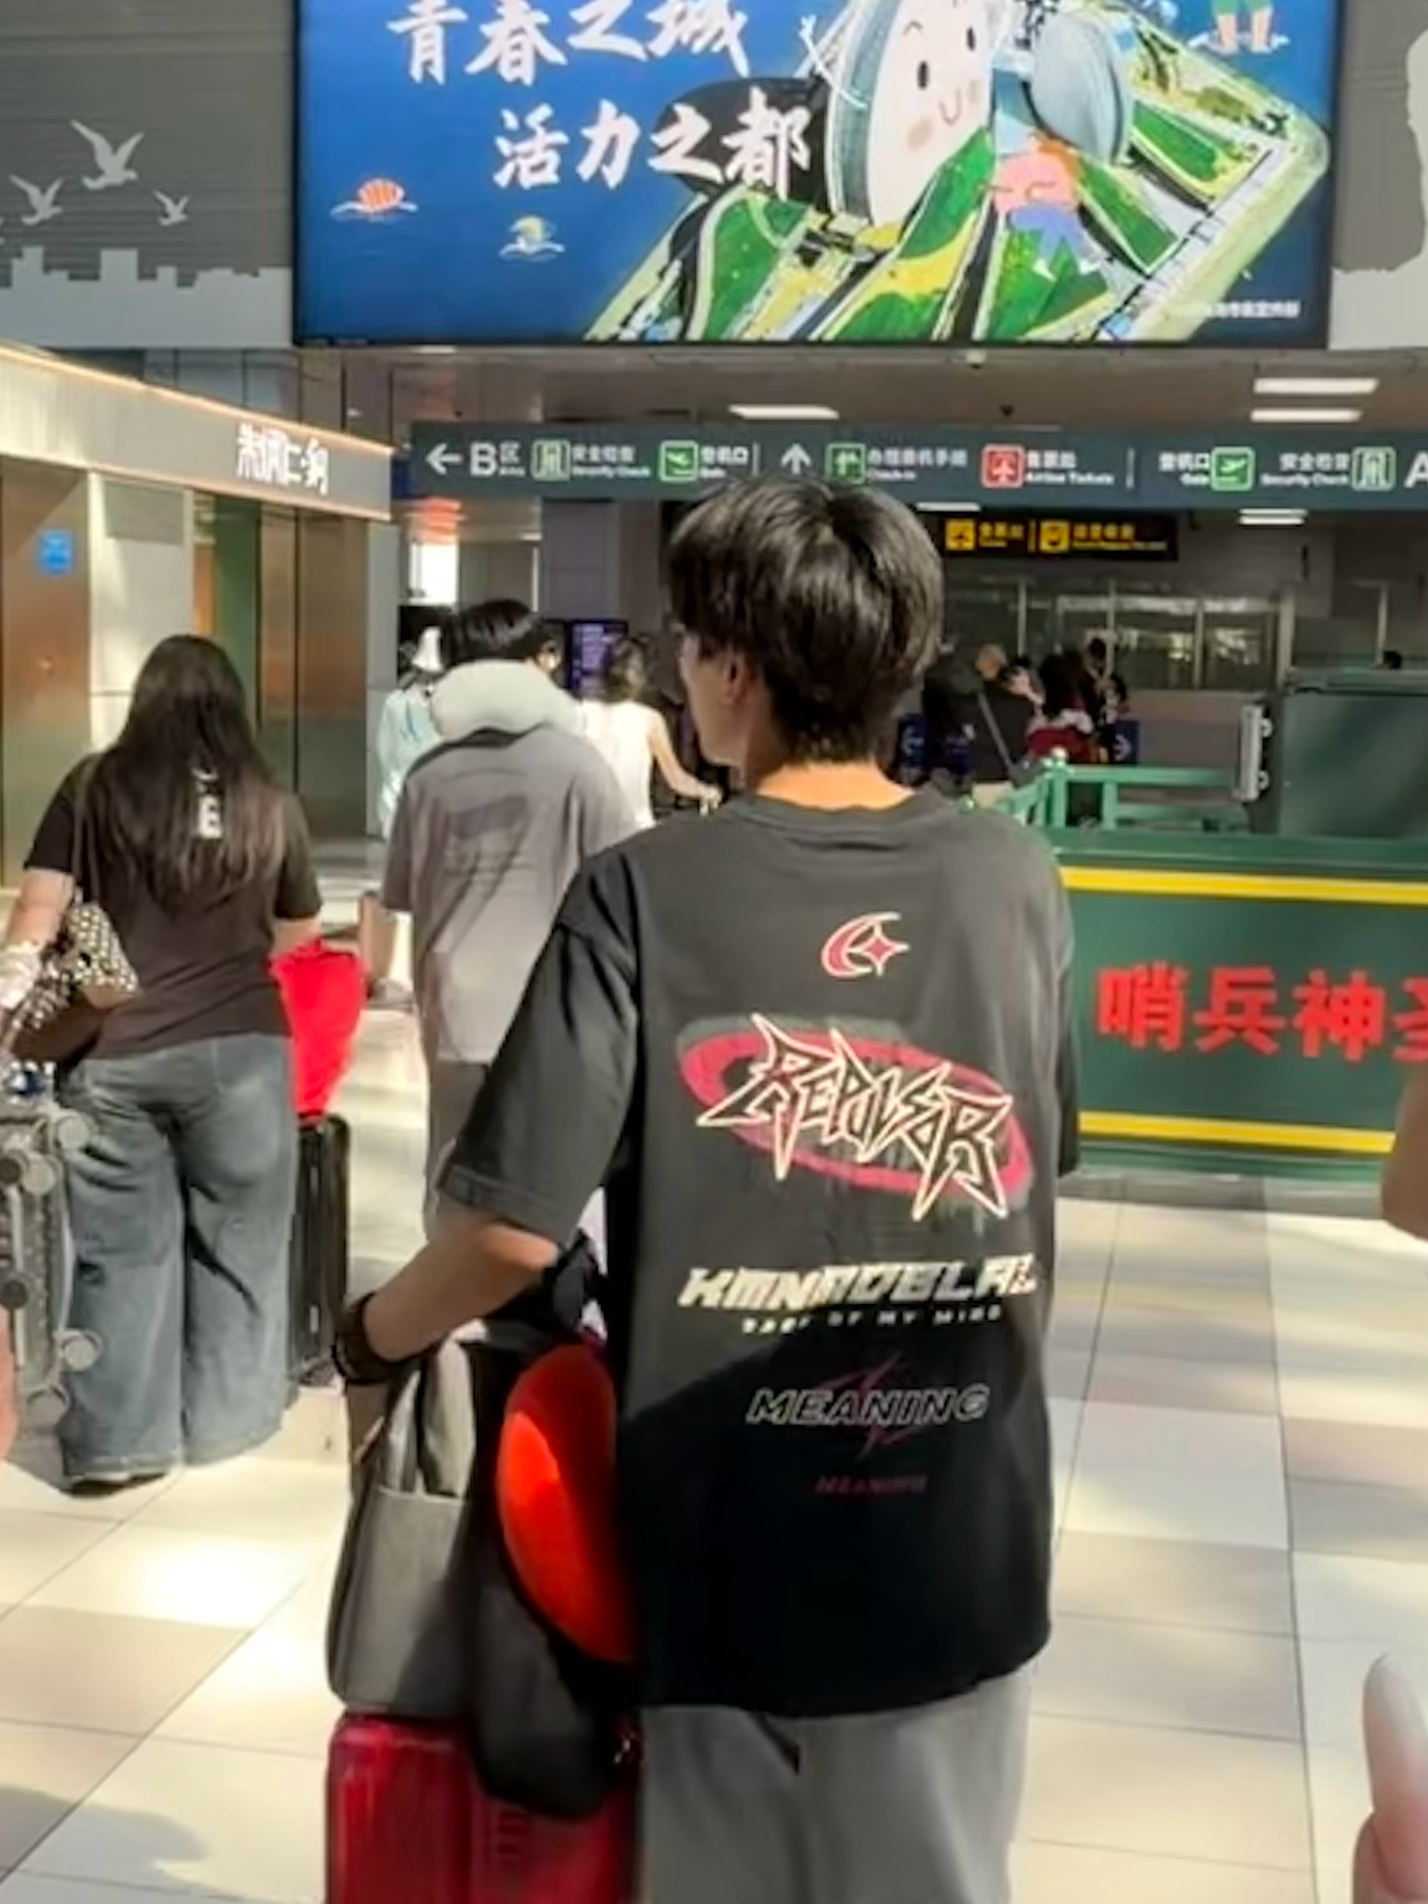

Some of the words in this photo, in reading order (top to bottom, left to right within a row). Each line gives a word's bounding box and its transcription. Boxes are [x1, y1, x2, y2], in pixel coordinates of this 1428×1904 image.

[491, 84, 812, 201] 活力之都
[470, 441, 497, 477] B
[745, 1382, 991, 1427] MEANING
